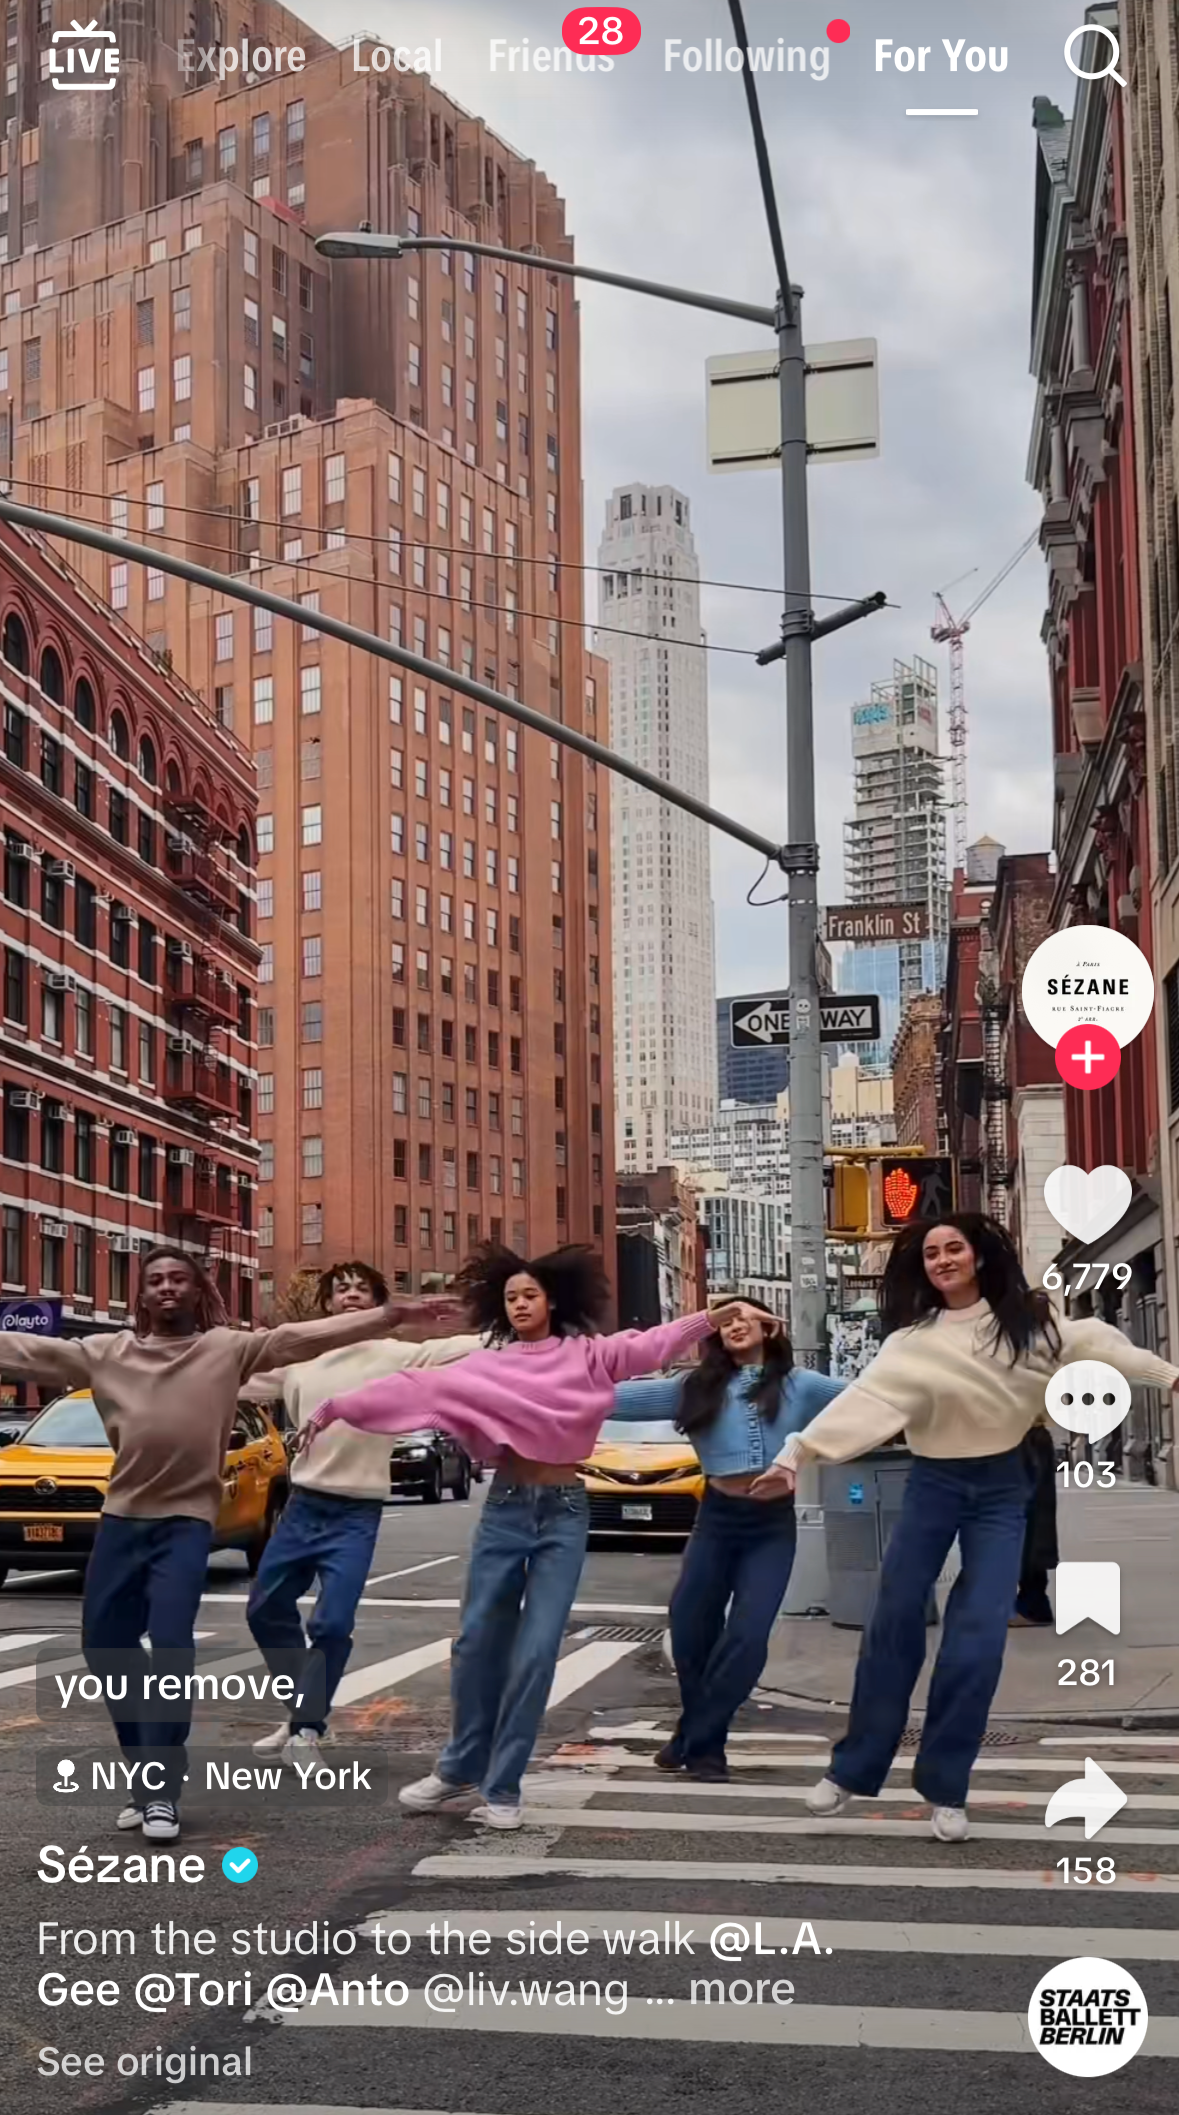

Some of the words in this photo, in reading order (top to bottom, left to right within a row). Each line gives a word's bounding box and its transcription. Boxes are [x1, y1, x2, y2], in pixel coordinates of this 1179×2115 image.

[828, 913, 894, 937] Franklin
[902, 911, 920, 934] St
[747, 1013, 790, 1032] ONE
[820, 1008, 866, 1029] WAY
